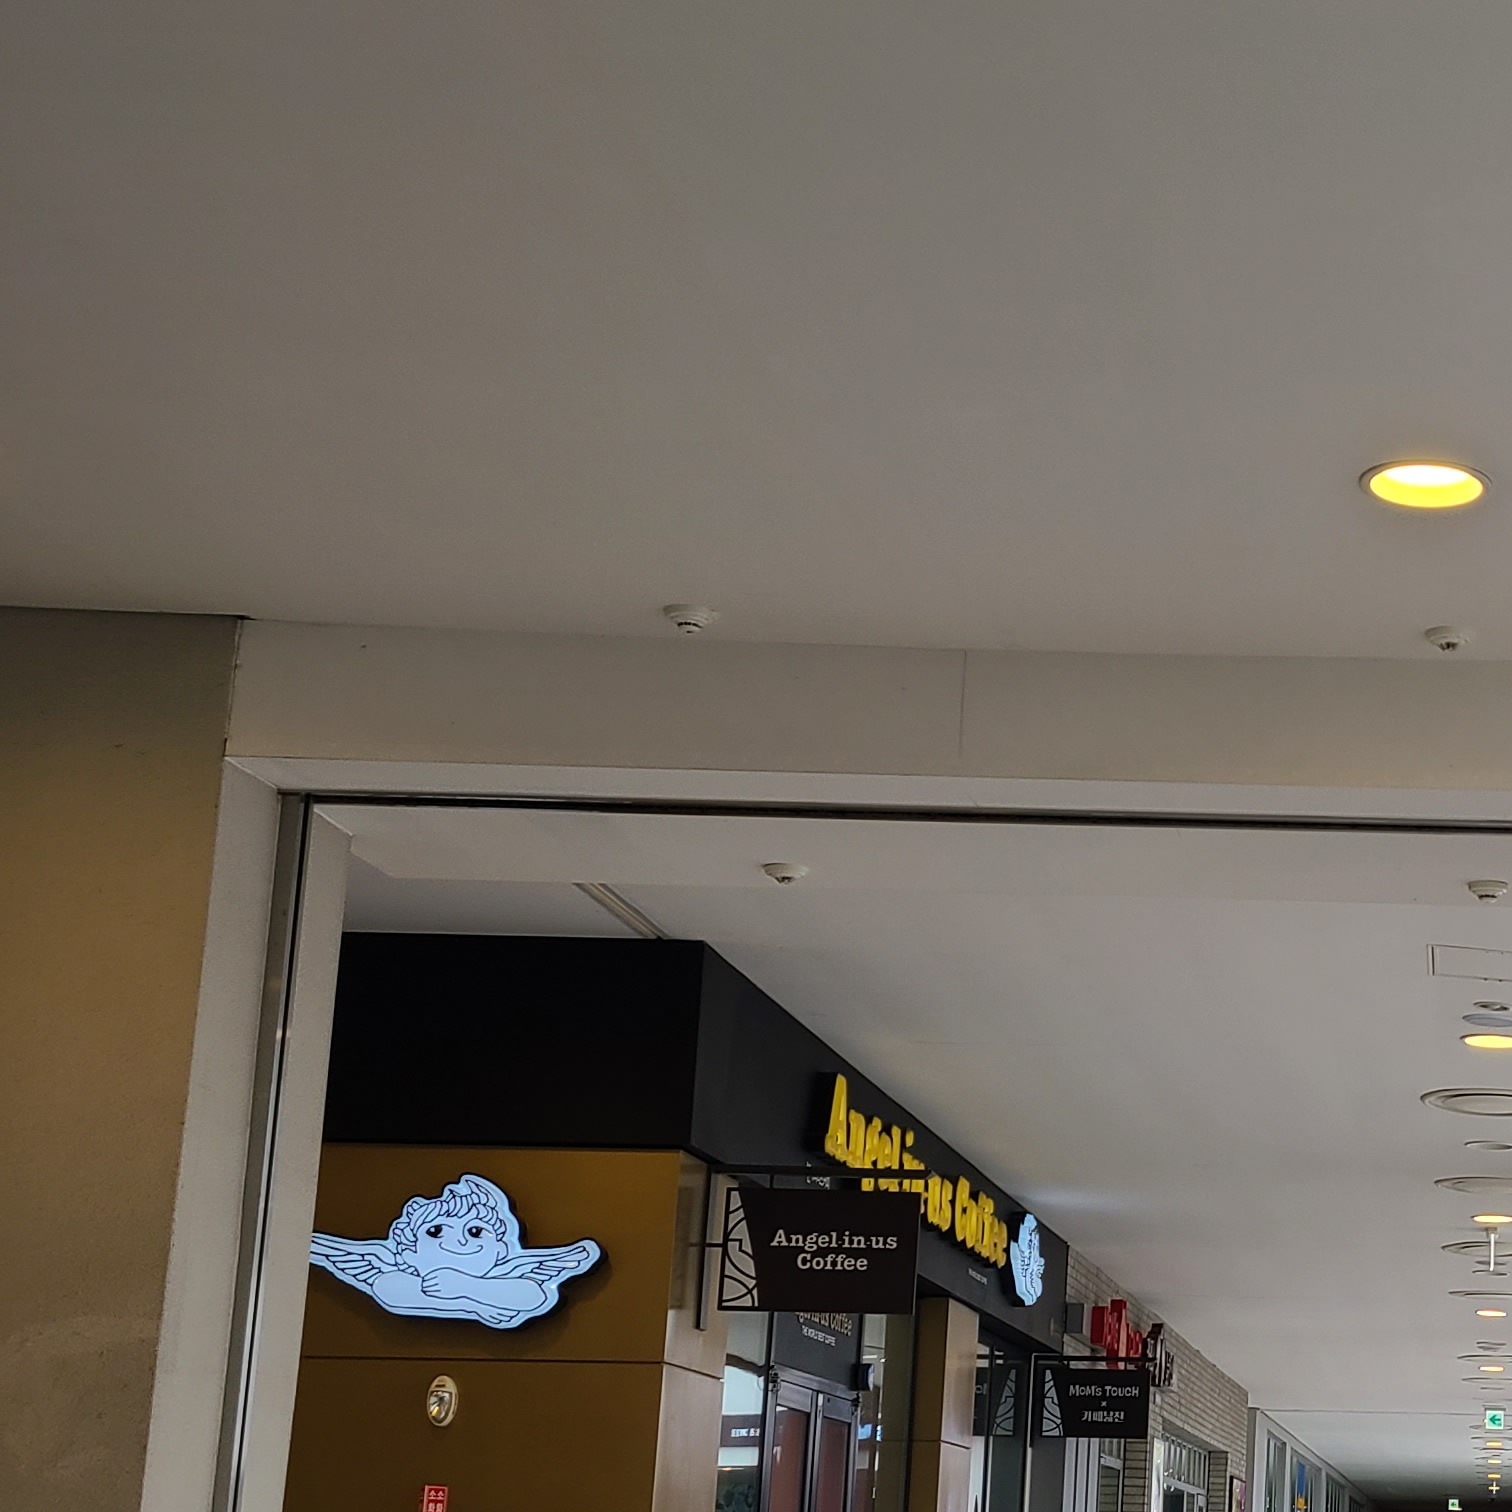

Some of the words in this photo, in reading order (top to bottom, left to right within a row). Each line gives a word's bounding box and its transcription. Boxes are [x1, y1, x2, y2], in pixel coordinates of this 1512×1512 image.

[954, 1175, 1008, 1269] Coffee
[769, 1229, 898, 1251] Angel-in-us
[796, 1253, 868, 1271] Coffee
[1104, 1385, 1140, 1398] TOUCH
